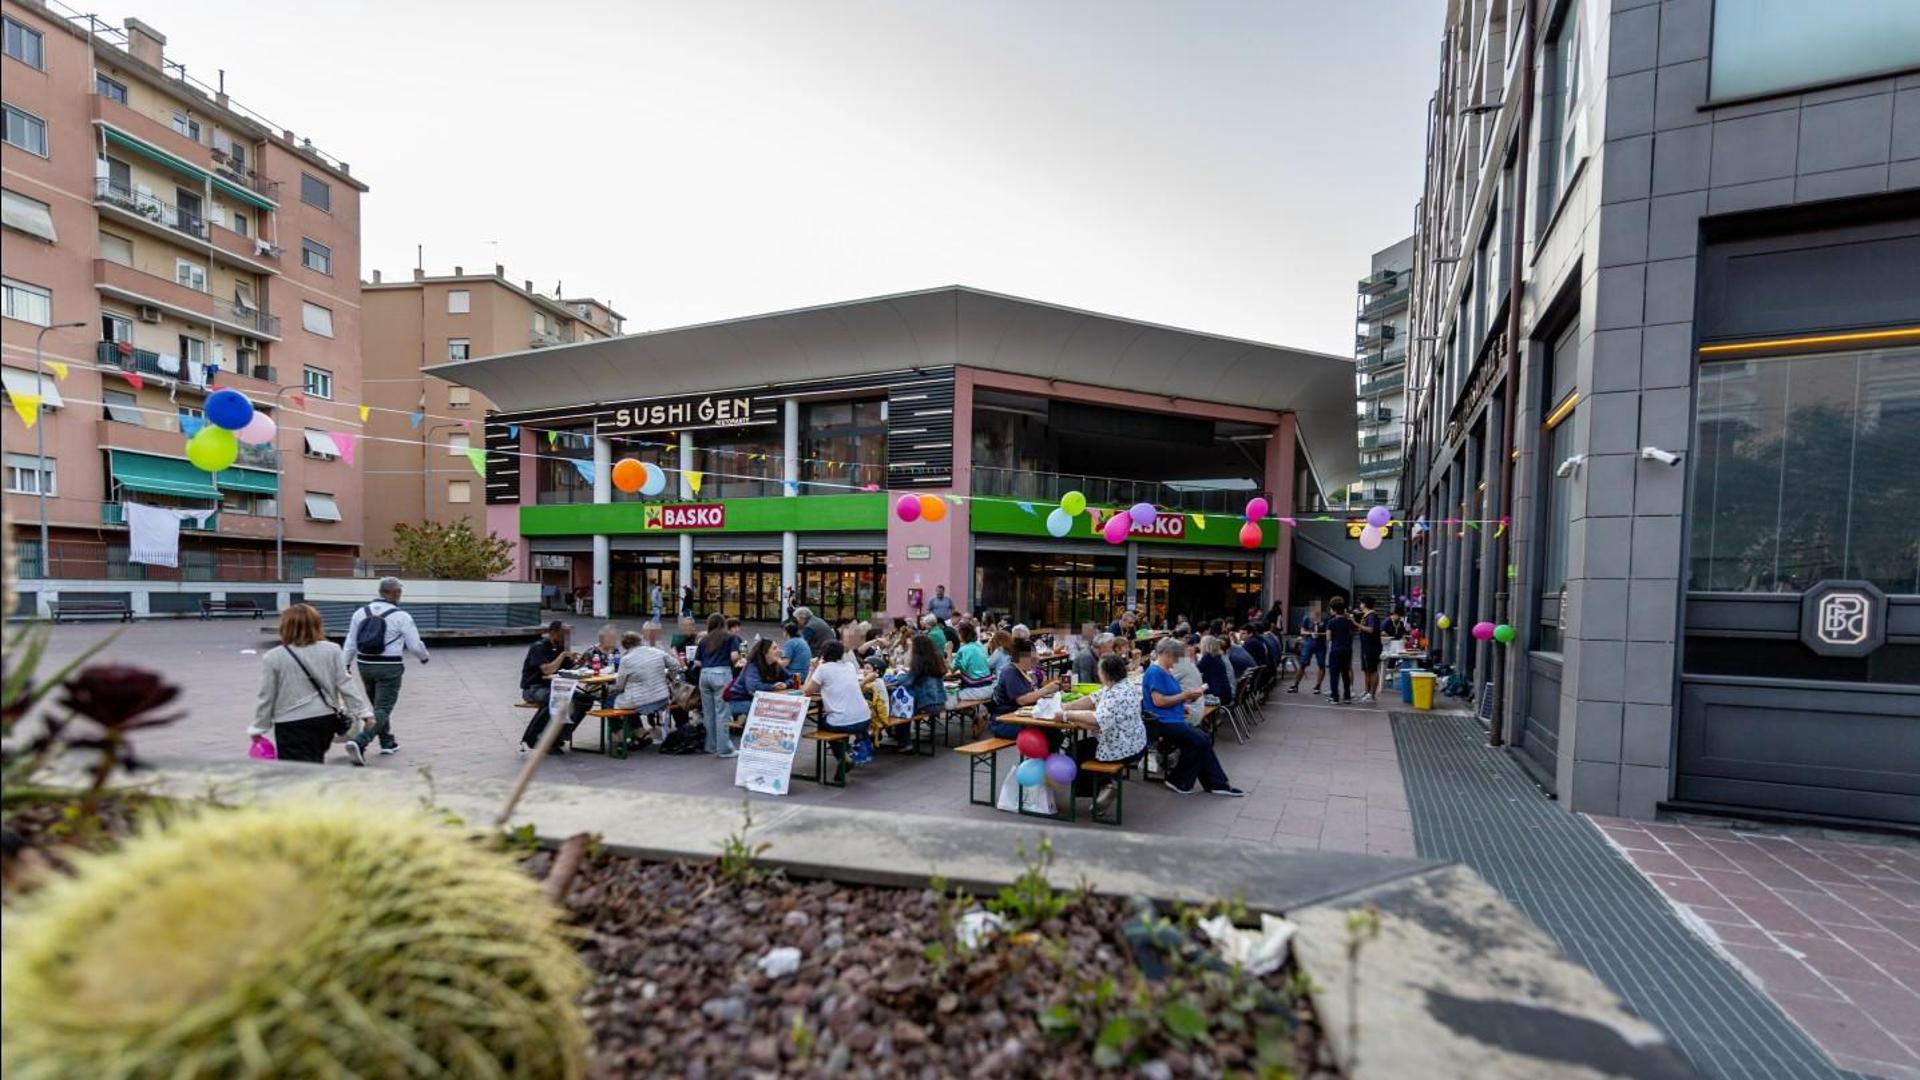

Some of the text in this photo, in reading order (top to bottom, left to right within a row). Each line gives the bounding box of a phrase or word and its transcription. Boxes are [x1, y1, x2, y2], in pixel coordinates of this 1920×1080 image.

[616, 397, 750, 427] SUSHI GEN
[664, 508, 721, 526] BASKO
[1128, 517, 1183, 535] ASKO
